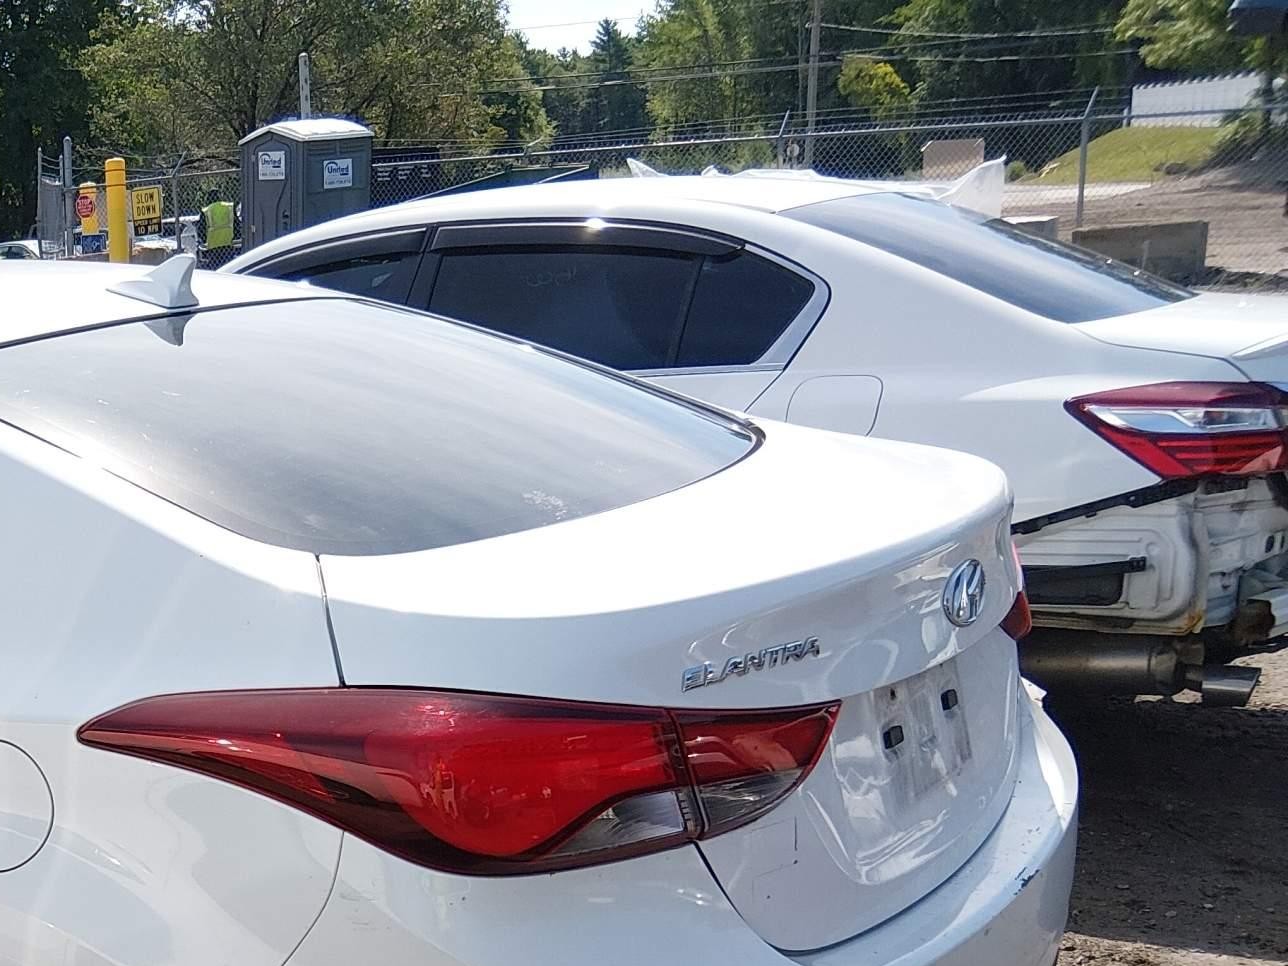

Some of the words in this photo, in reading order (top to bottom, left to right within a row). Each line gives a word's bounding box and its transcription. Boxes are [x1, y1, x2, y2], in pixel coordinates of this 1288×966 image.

[327, 163, 349, 174] United
[136, 191, 155, 204] SLOW
[136, 204, 156, 216] DOWN
[137, 226, 146, 234] 10
[681, 635, 821, 693] ELANTRA
